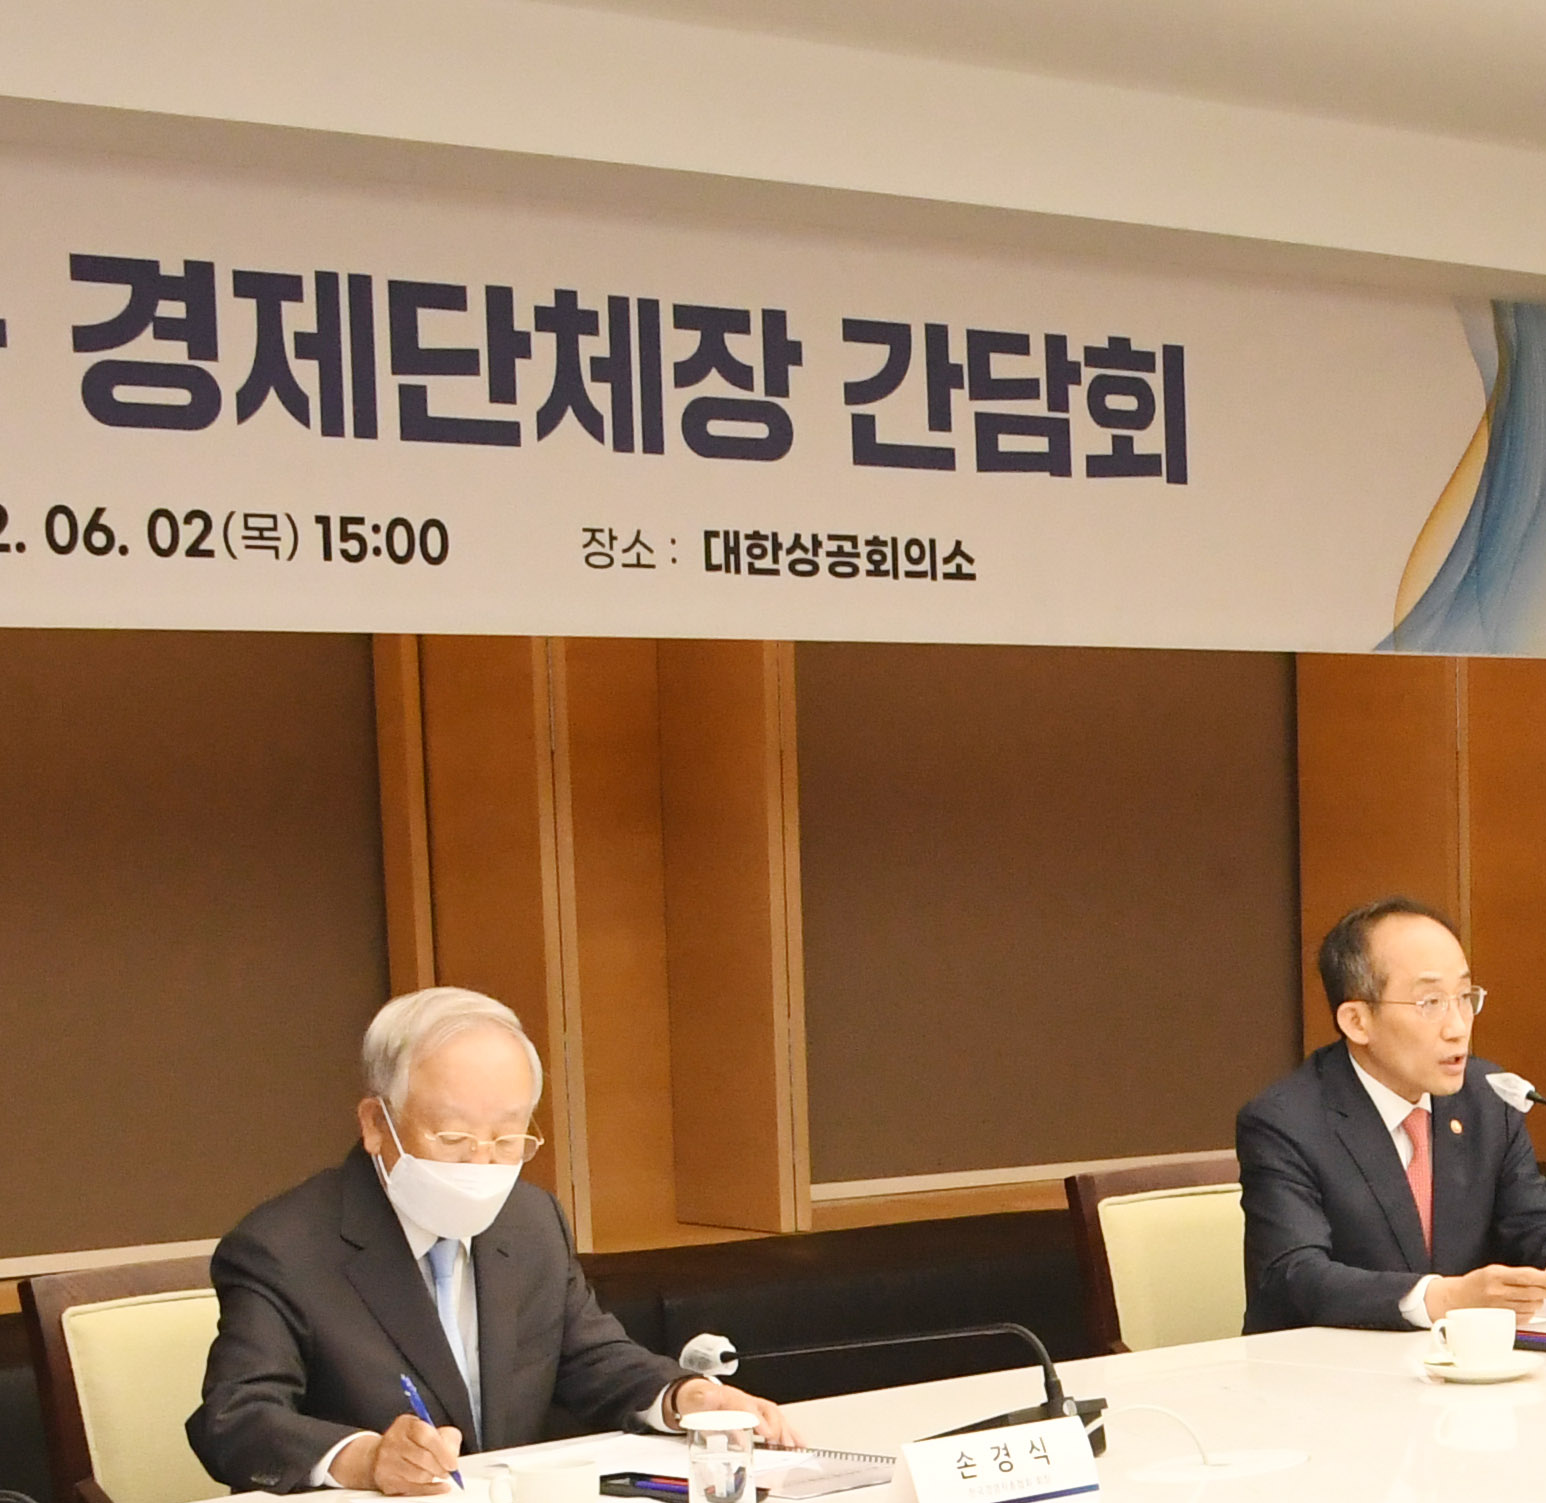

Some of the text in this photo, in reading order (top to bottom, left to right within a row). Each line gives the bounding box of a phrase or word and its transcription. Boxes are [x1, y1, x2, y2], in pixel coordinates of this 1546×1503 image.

[69, 253, 1188, 485] 경제단체장 간담회
[45, 504, 129, 556] 06.
[315, 514, 449, 566] 15:00
[704, 529, 977, 582] 대한상공회의소
